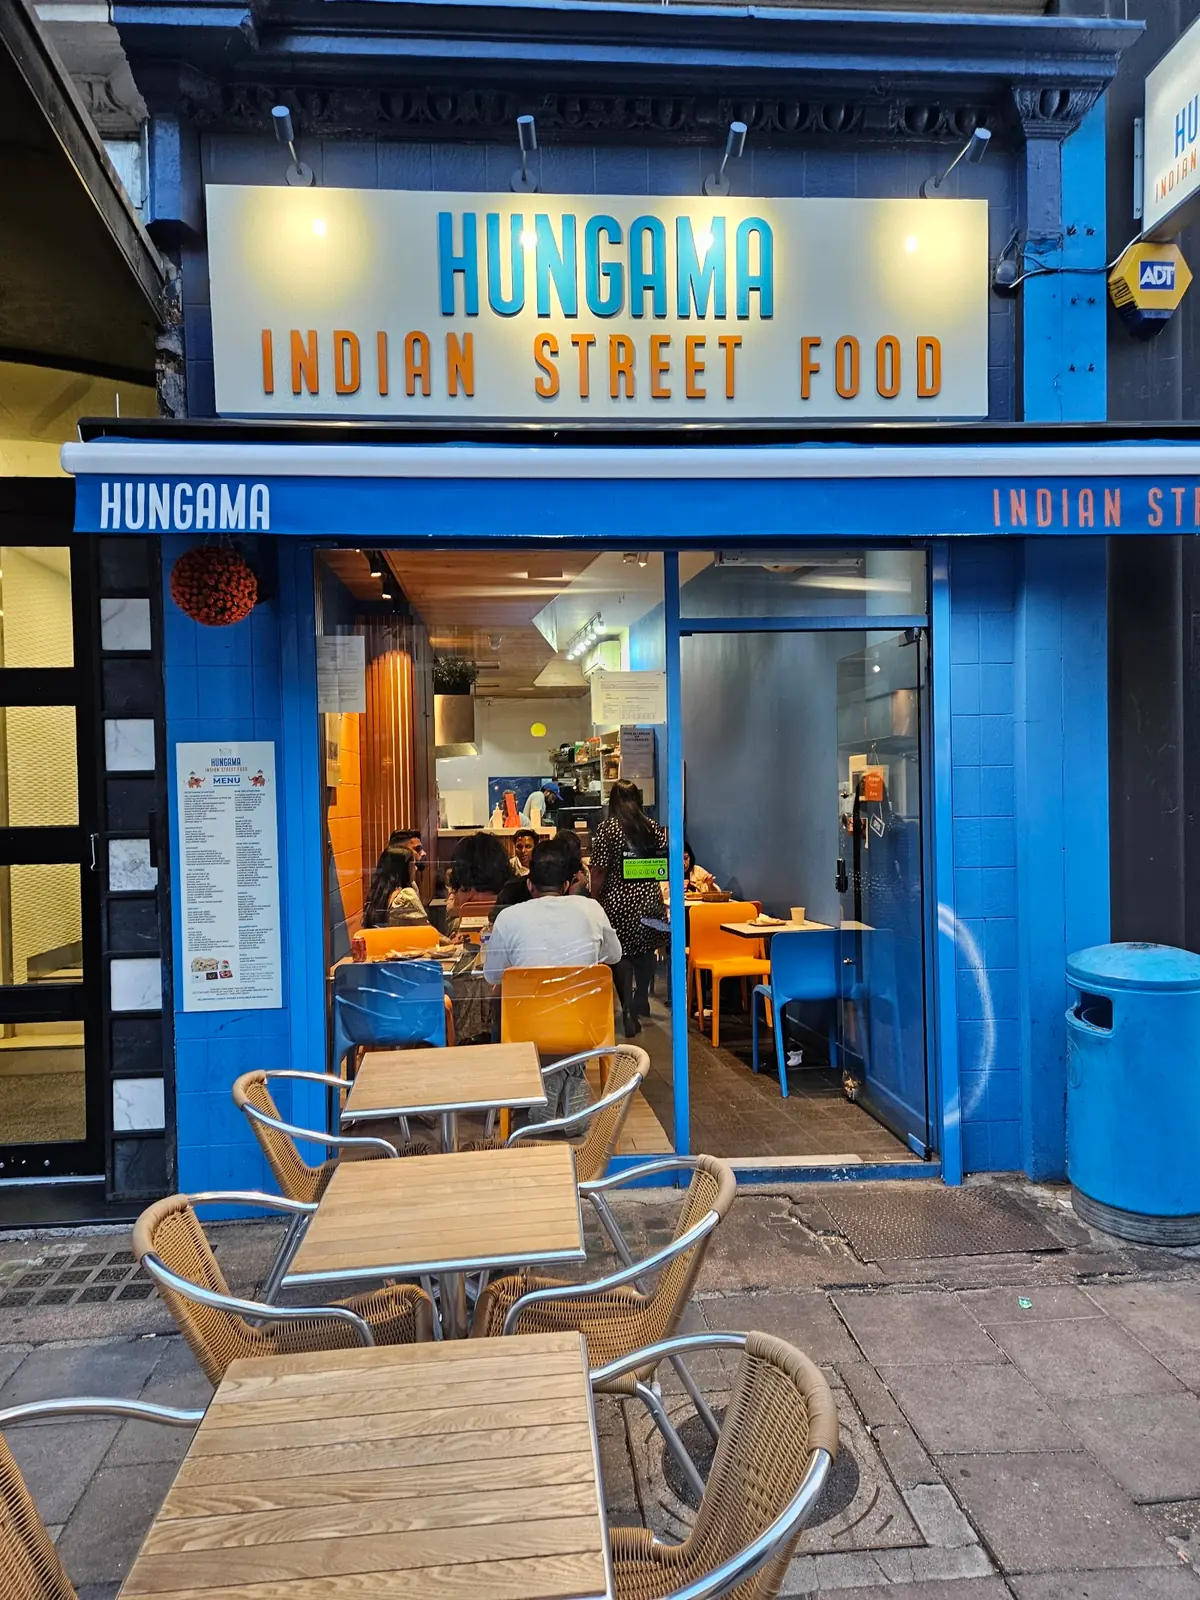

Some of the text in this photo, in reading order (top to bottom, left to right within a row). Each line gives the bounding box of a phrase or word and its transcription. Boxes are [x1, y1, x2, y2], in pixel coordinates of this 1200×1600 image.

[1155, 148, 1197, 203] INDIAN
[439, 211, 775, 321] HUNGAMA
[1140, 265, 1175, 286] ADT
[261, 328, 942, 400] INDIAN STREET FOOD
[100, 482, 271, 531] HUNGAMA
[993, 487, 1122, 528] INDIAN
[210, 757, 241, 767] HUNGAMA
